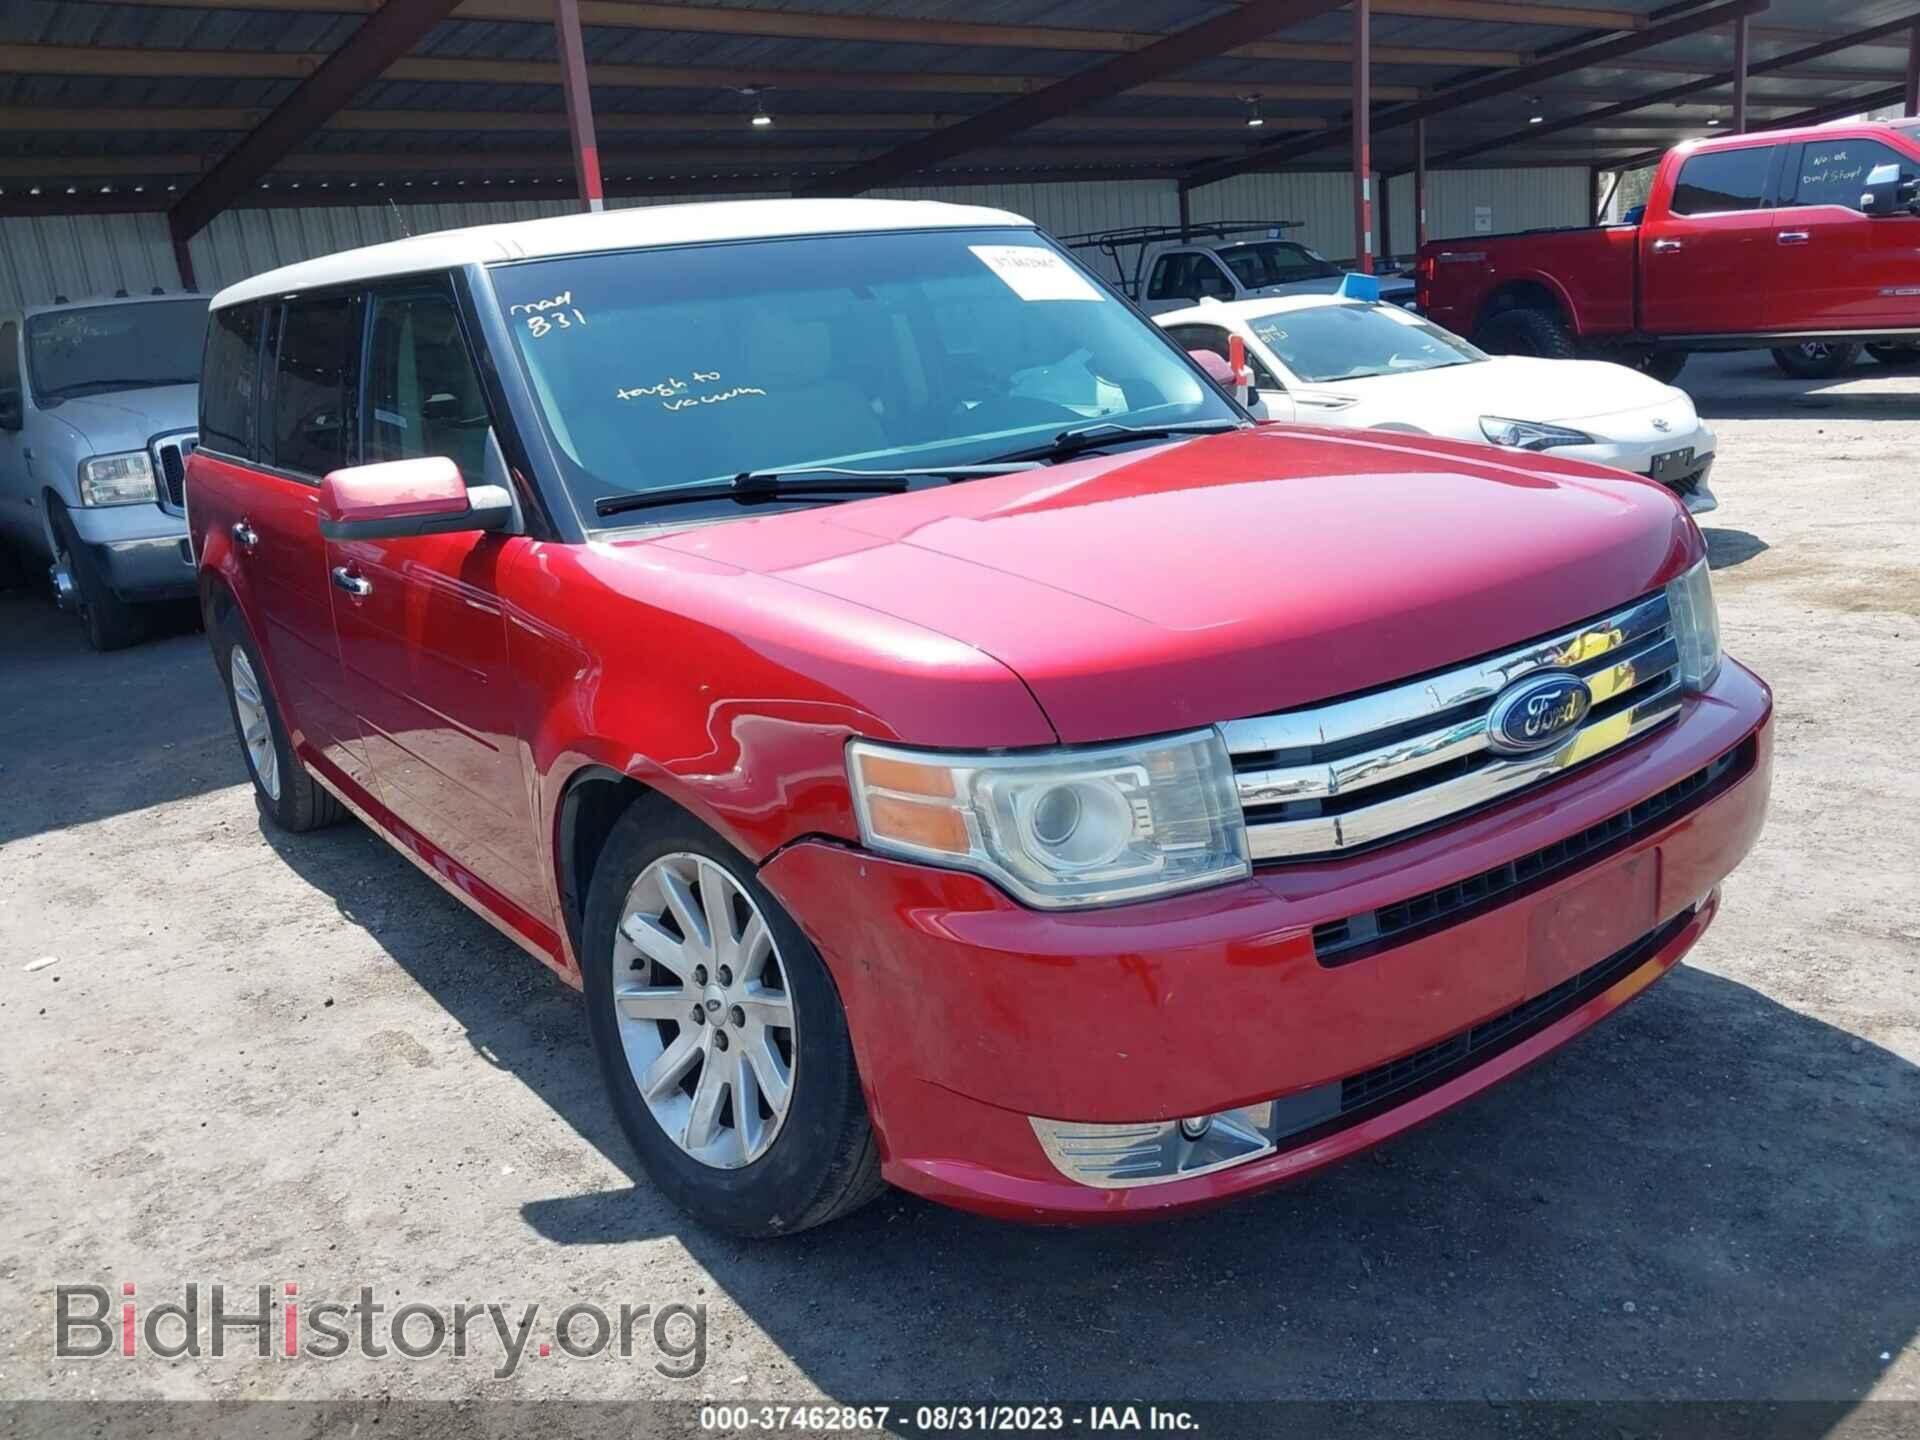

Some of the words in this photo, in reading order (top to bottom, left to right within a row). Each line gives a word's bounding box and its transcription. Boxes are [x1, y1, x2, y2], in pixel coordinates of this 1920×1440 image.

[527, 308, 586, 337] 831
[616, 377, 688, 400] tough
[692, 371, 721, 383] to
[1524, 689, 1577, 736] Ford
